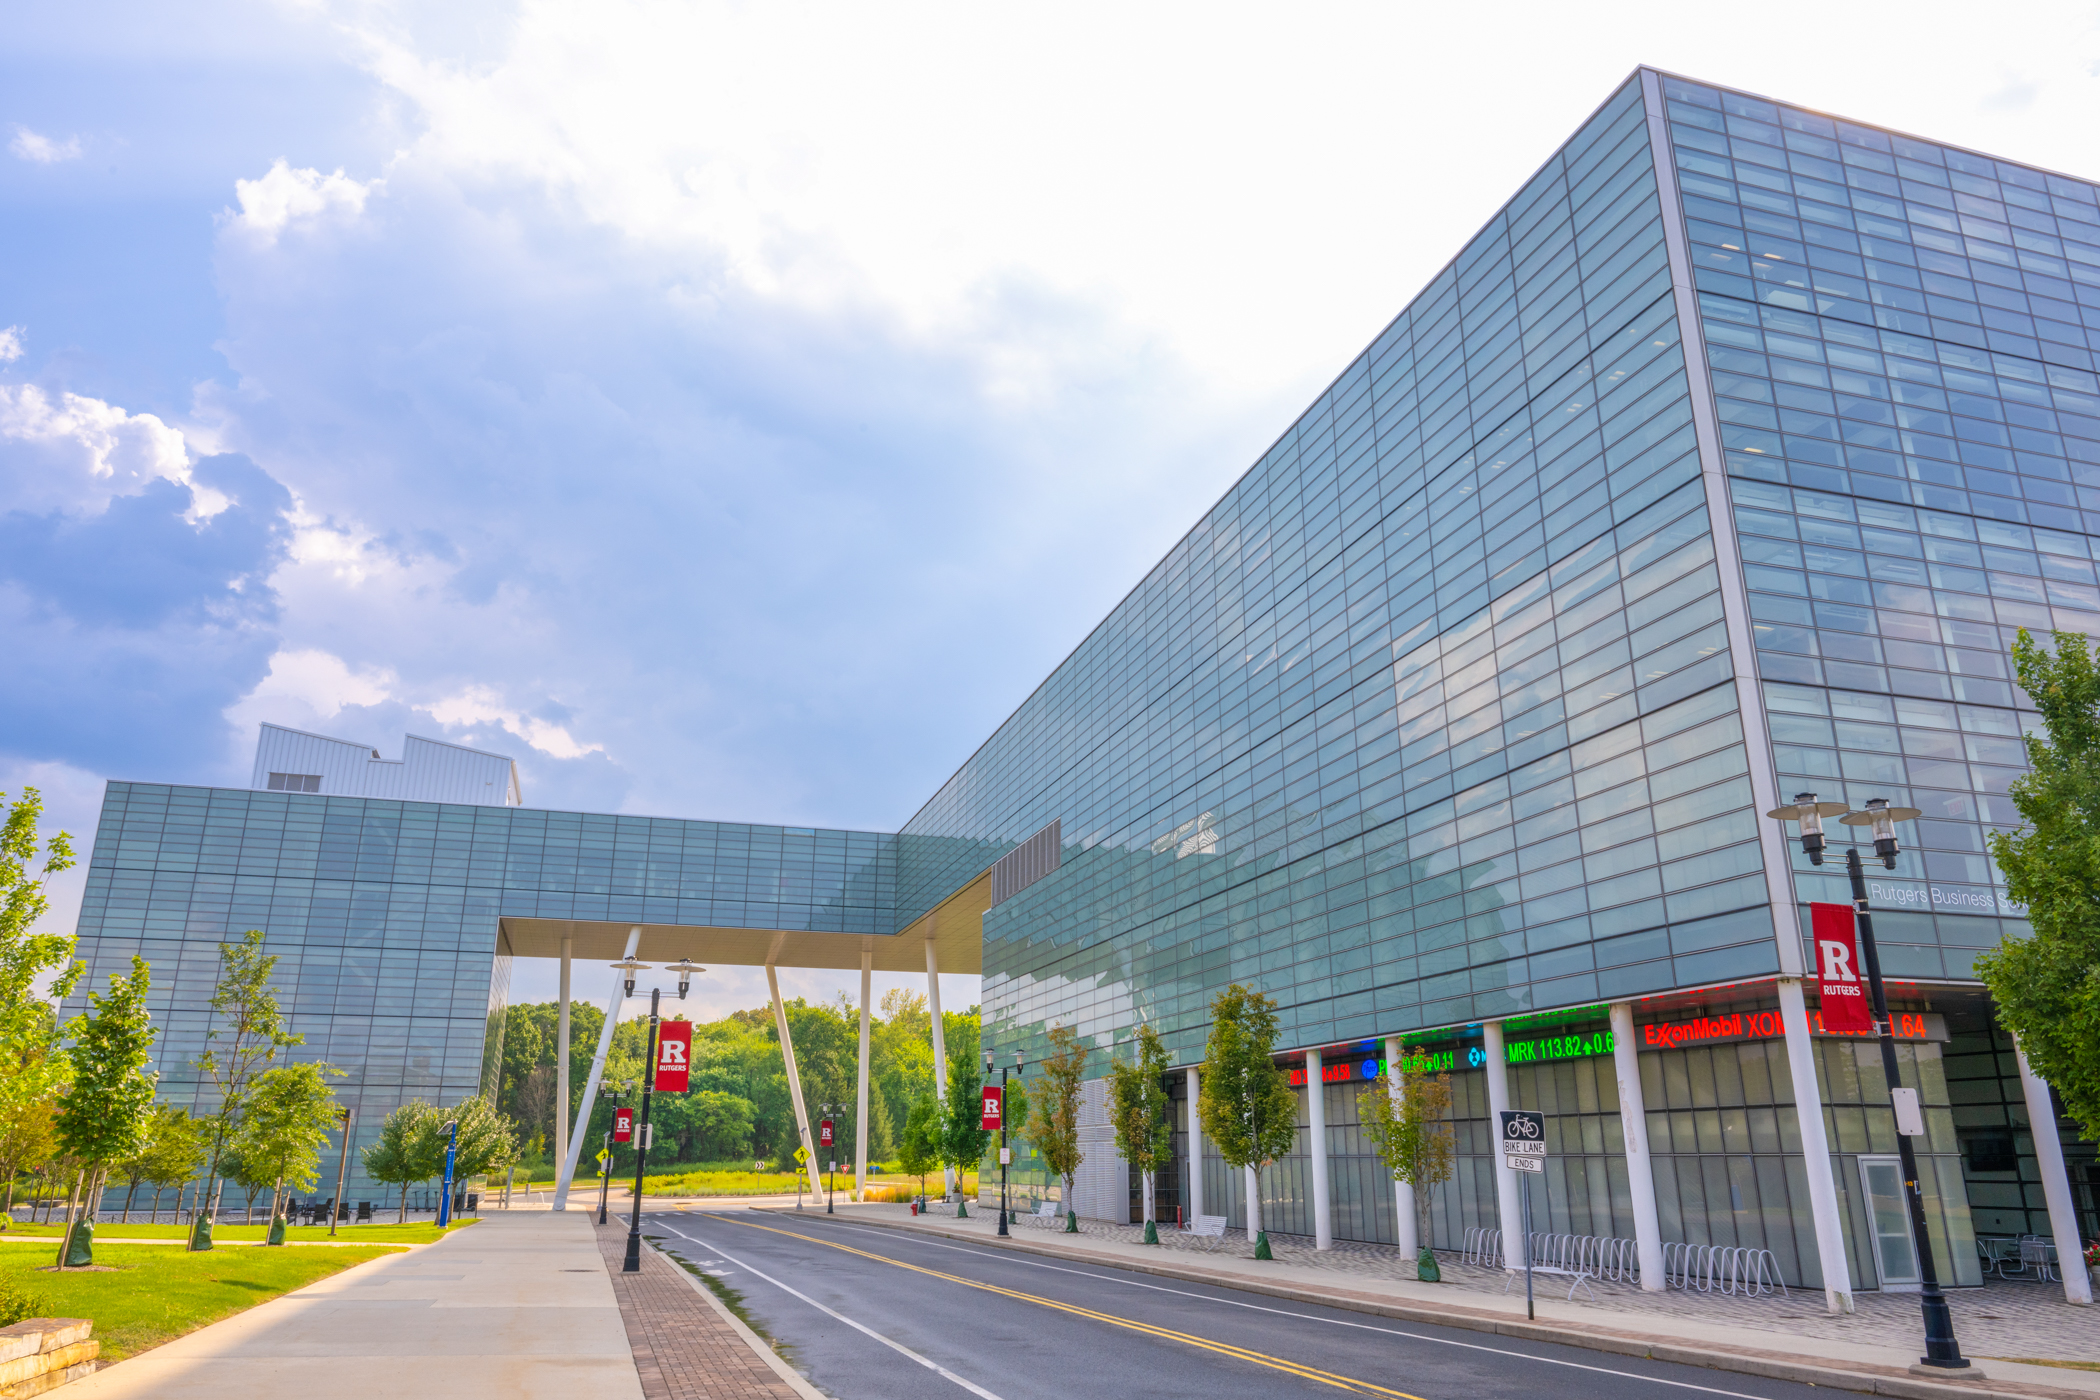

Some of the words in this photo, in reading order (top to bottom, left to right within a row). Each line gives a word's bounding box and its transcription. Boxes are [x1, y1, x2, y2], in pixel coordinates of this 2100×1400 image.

[1870, 883, 1928, 905] Rutgers
[1930, 887, 1995, 907] Business
[1819, 940, 1857, 982] R
[1823, 985, 1861, 997] RUTGERS
[1644, 1013, 1742, 1048] ExxonMobil
[661, 1040, 686, 1063] R
[1508, 1041, 1537, 1063] MRK
[1540, 1036, 1582, 1059] 113.82
[1593, 1031, 1615, 1054] 0.6
[1333, 1063, 1350, 1081] 9.58
[984, 1099, 999, 1113] R
[617, 1117, 630, 1129] R
[822, 1128, 831, 1136] R
[1505, 1142, 1521, 1152] BIKE
[1523, 1142, 1544, 1153] LANE
[1514, 1158, 1534, 1169] ENDS
